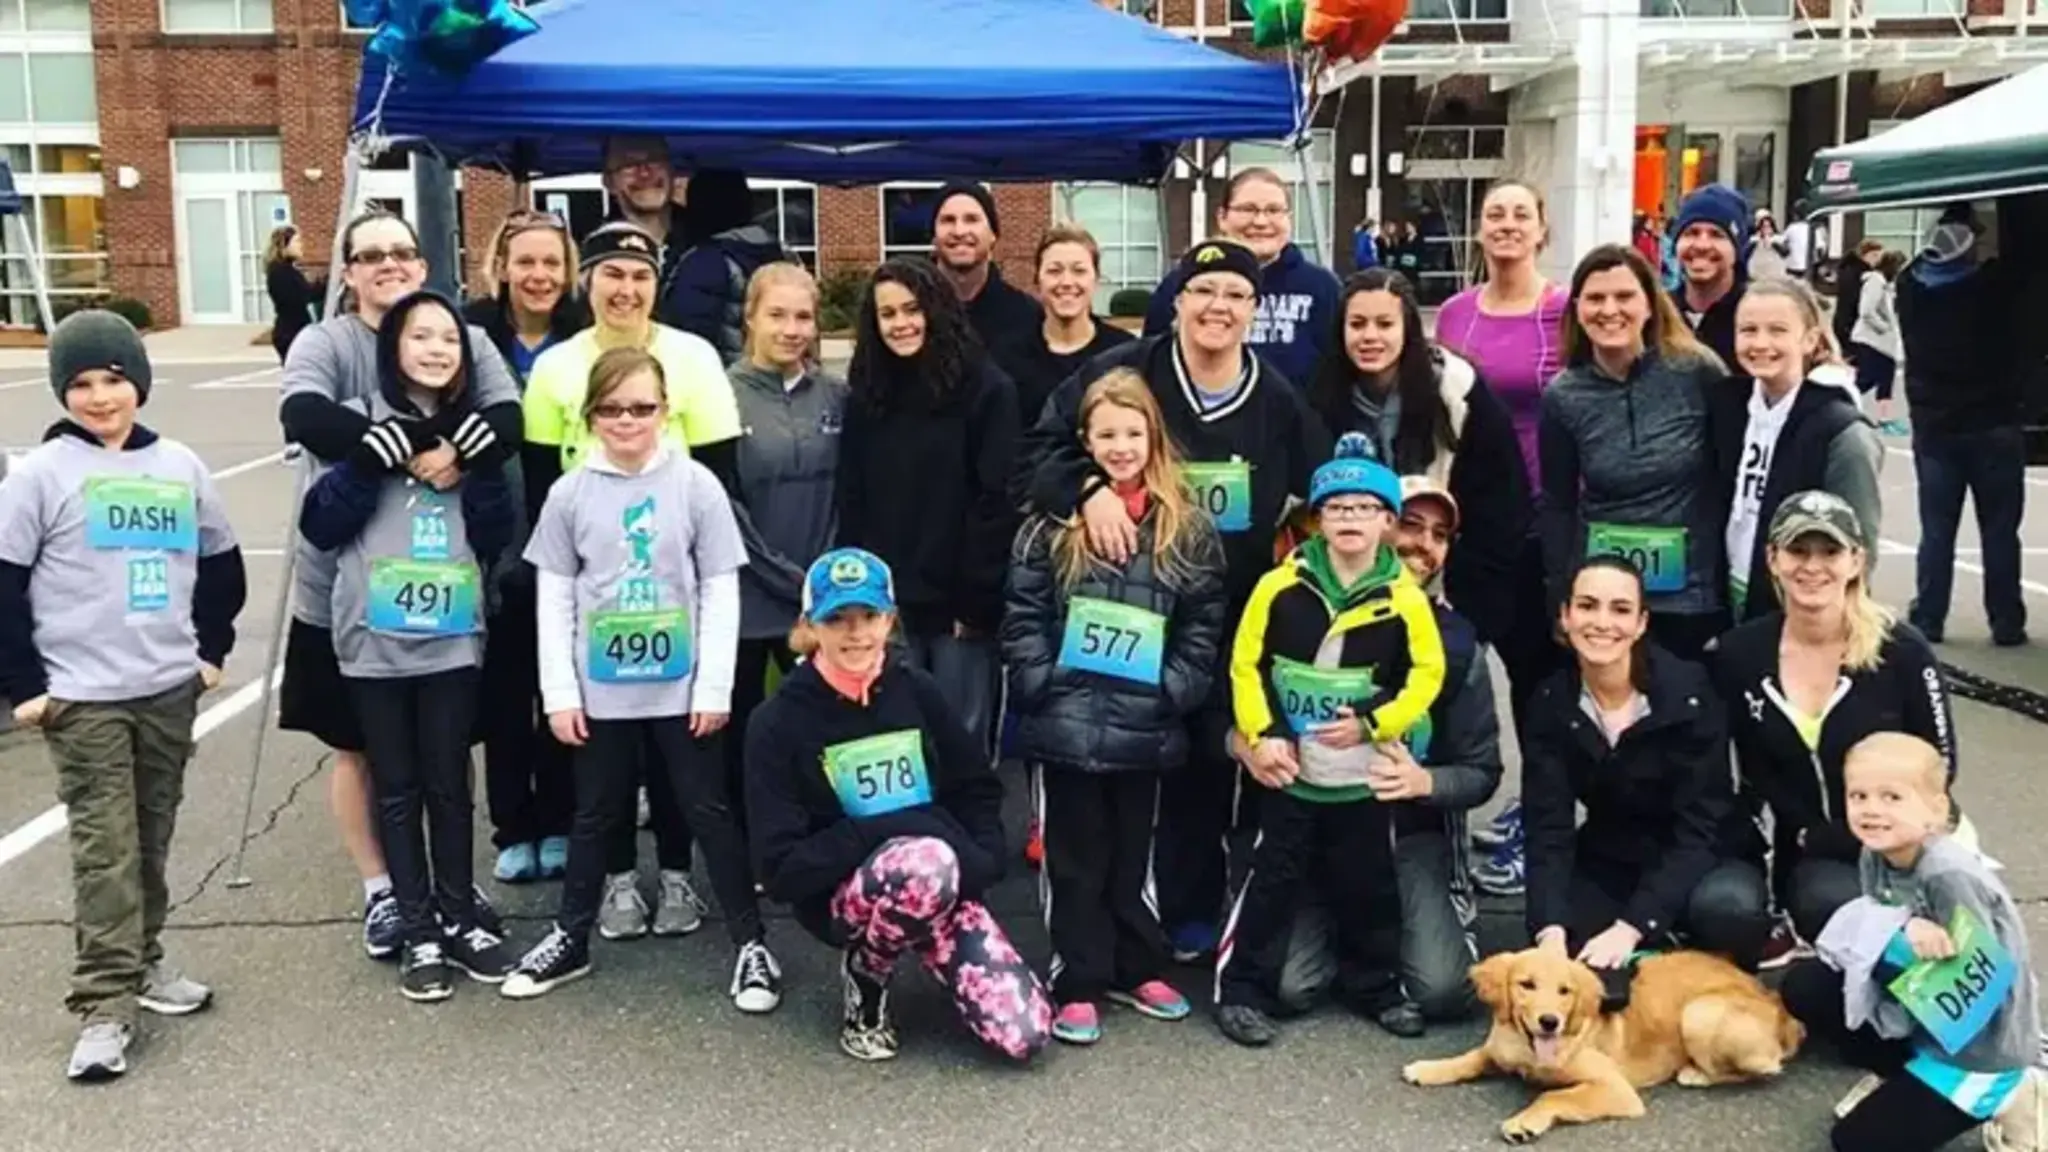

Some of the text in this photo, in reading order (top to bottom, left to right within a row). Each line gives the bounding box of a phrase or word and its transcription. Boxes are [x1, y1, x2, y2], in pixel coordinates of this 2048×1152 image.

[108, 505, 177, 533] DASH
[1610, 546, 1660, 576] 01
[394, 582, 452, 615] 491
[605, 630, 671, 664] 490
[1081, 621, 1142, 661] 577
[856, 755, 917, 799] 578
[1934, 946, 1997, 1022] DASH
